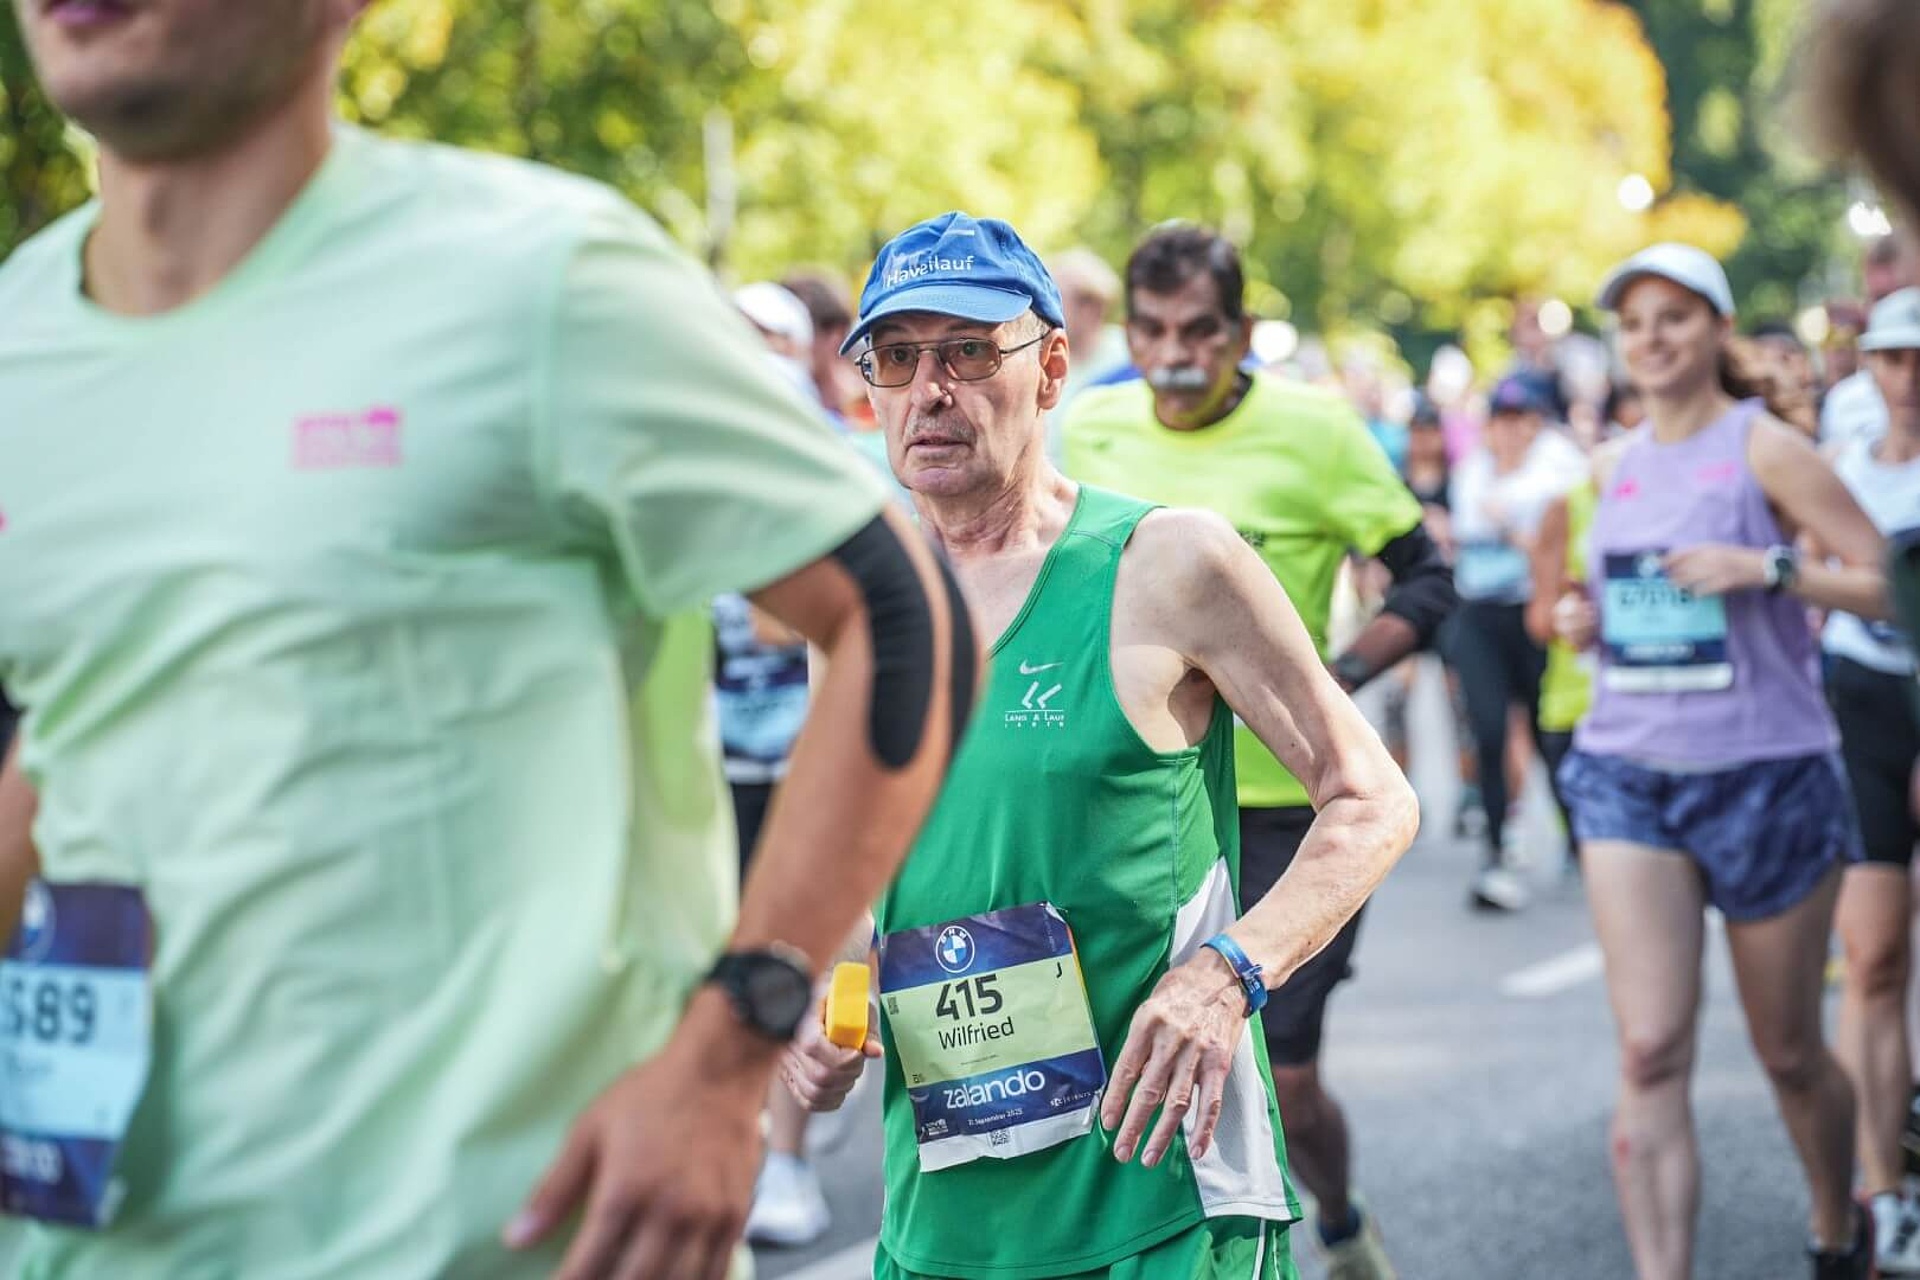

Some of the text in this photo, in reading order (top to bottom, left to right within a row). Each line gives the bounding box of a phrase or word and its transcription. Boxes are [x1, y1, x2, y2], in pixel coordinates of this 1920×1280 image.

[1056, 962, 1063, 979] J
[935, 973, 1004, 1021] 415
[938, 1016, 1015, 1050] Wilfried
[943, 1070, 1046, 1109] zalando
